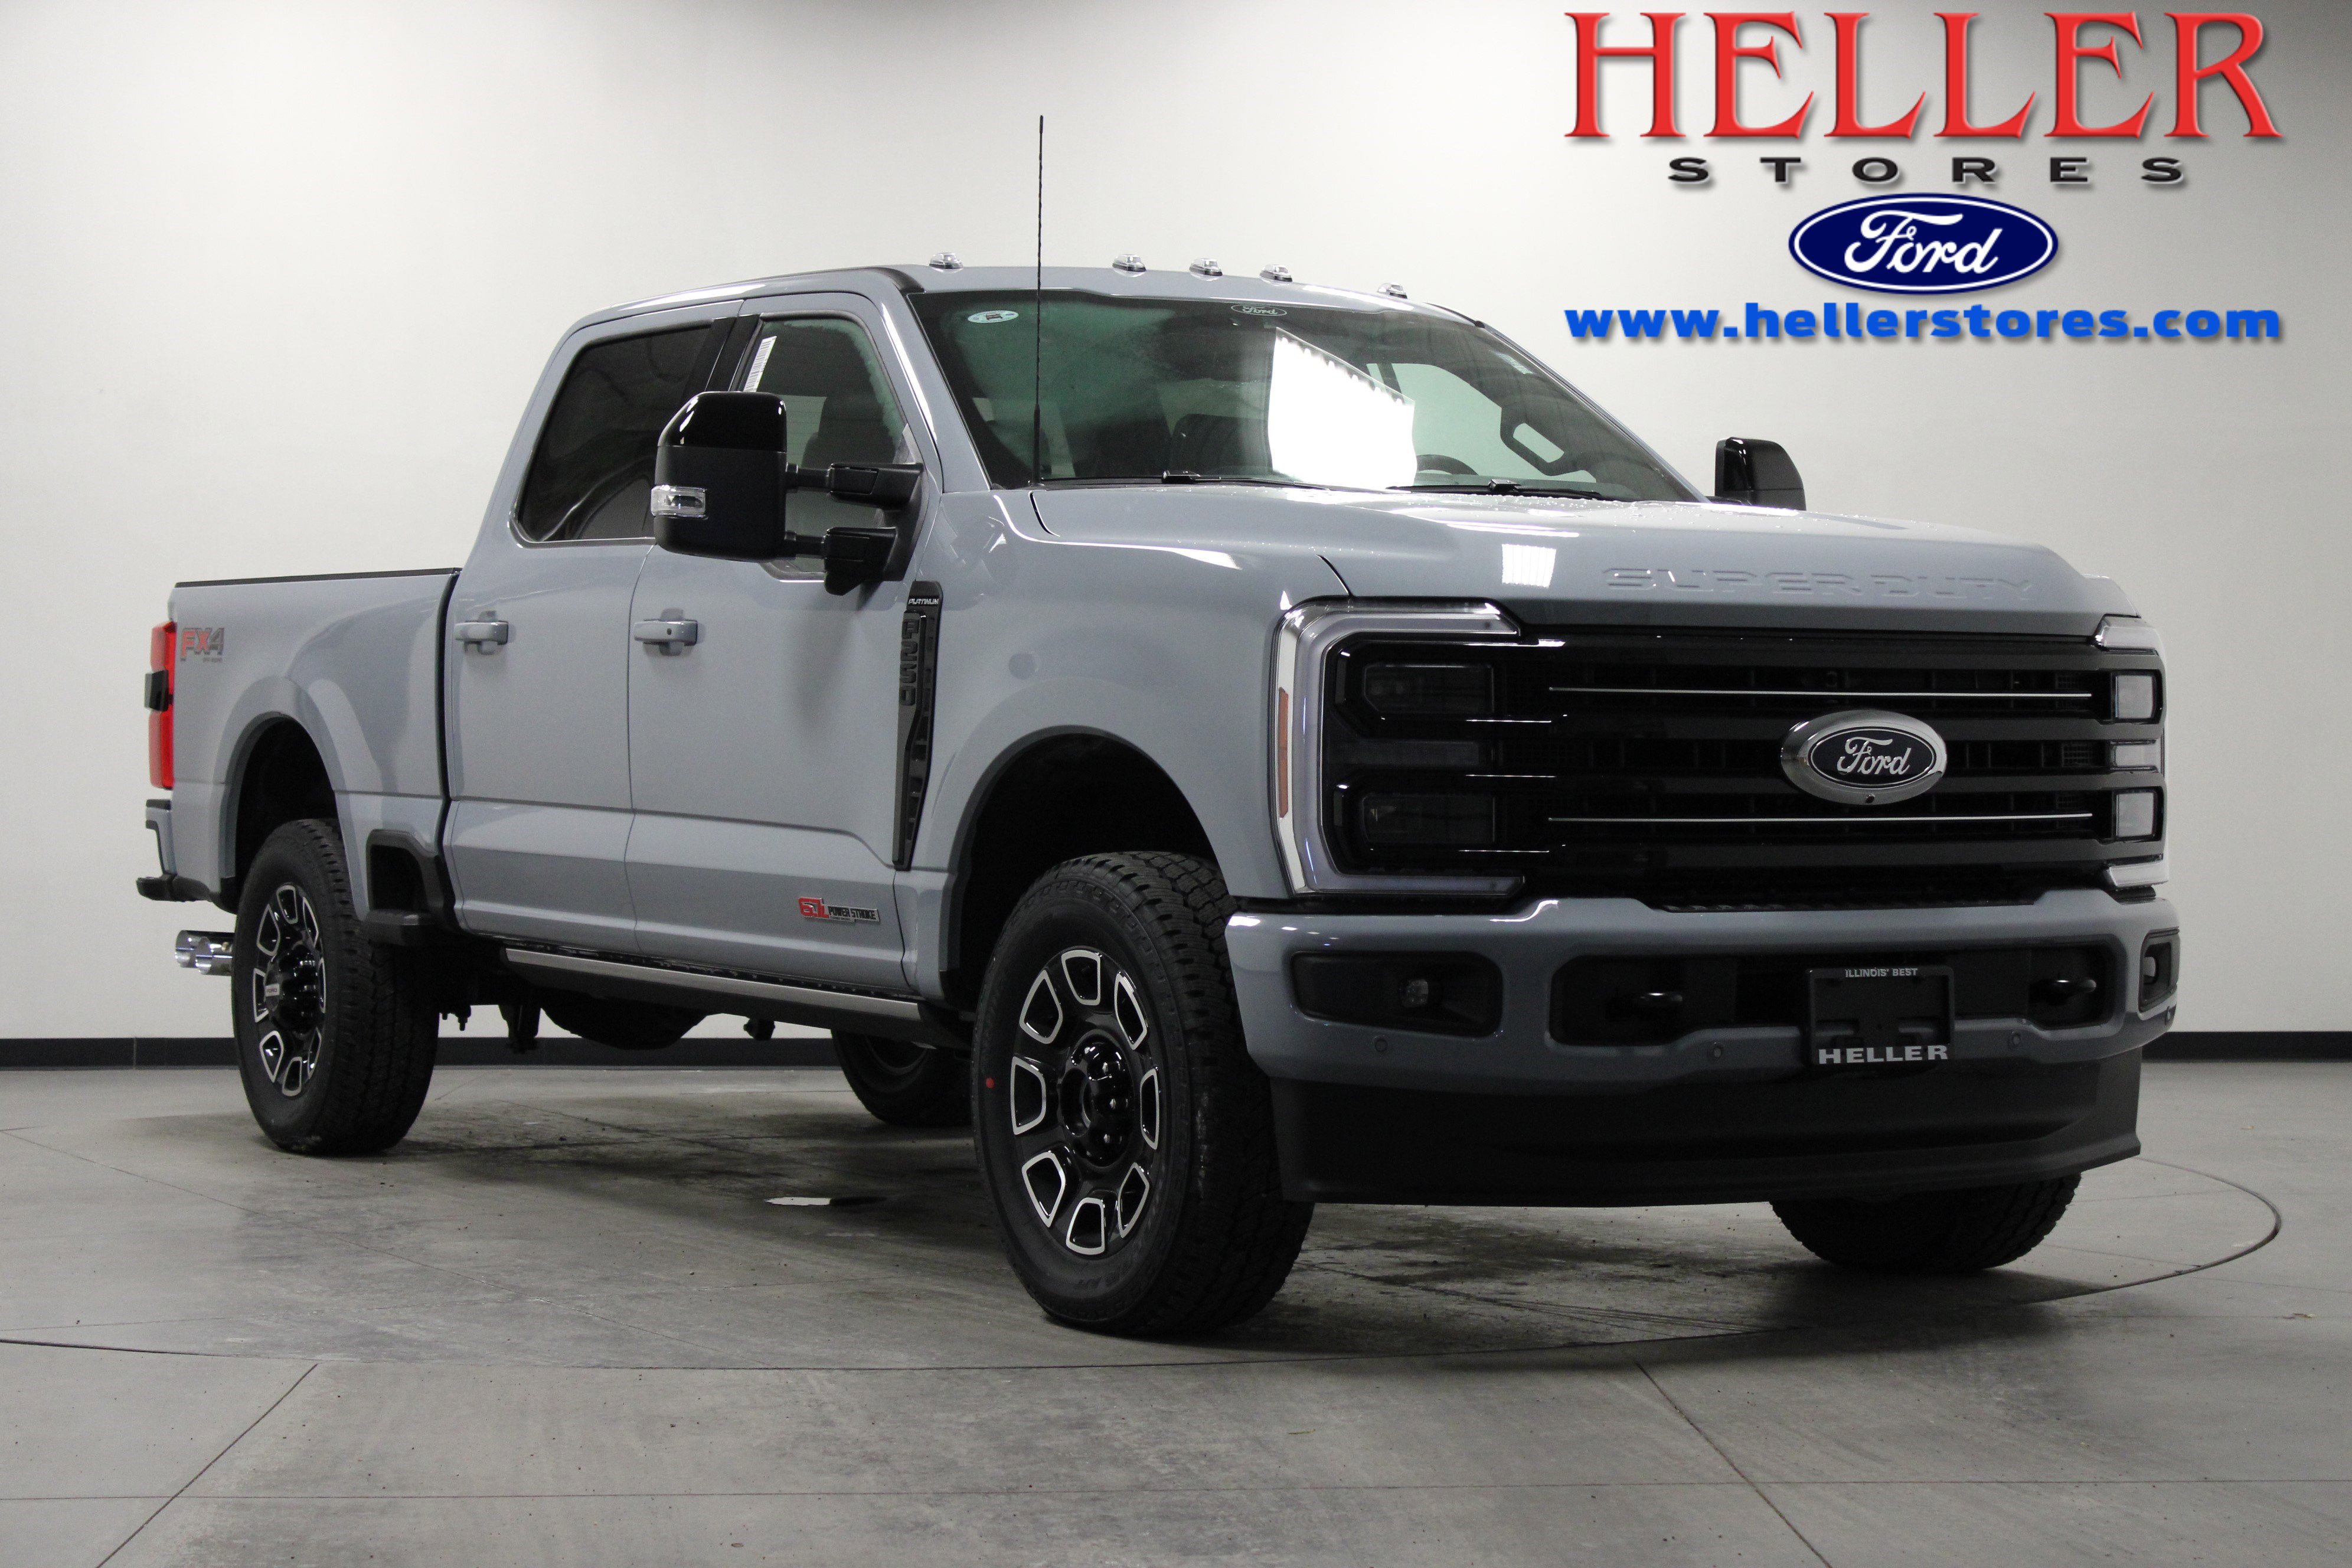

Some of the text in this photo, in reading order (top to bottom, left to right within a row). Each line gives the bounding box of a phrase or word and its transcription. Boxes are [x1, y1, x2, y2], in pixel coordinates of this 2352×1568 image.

[1242, 306, 1278, 314] Ford
[1603, 567, 2033, 600] SUPER DUTY
[180, 628, 224, 661] FX4
[1837, 736, 1912, 775] Ford
[828, 906, 850, 917] POWER
[850, 909, 877, 920] STROKE
[1845, 968, 1917, 978] ILLINOIS' BEST
[1818, 1045, 1948, 1064] HELLER
